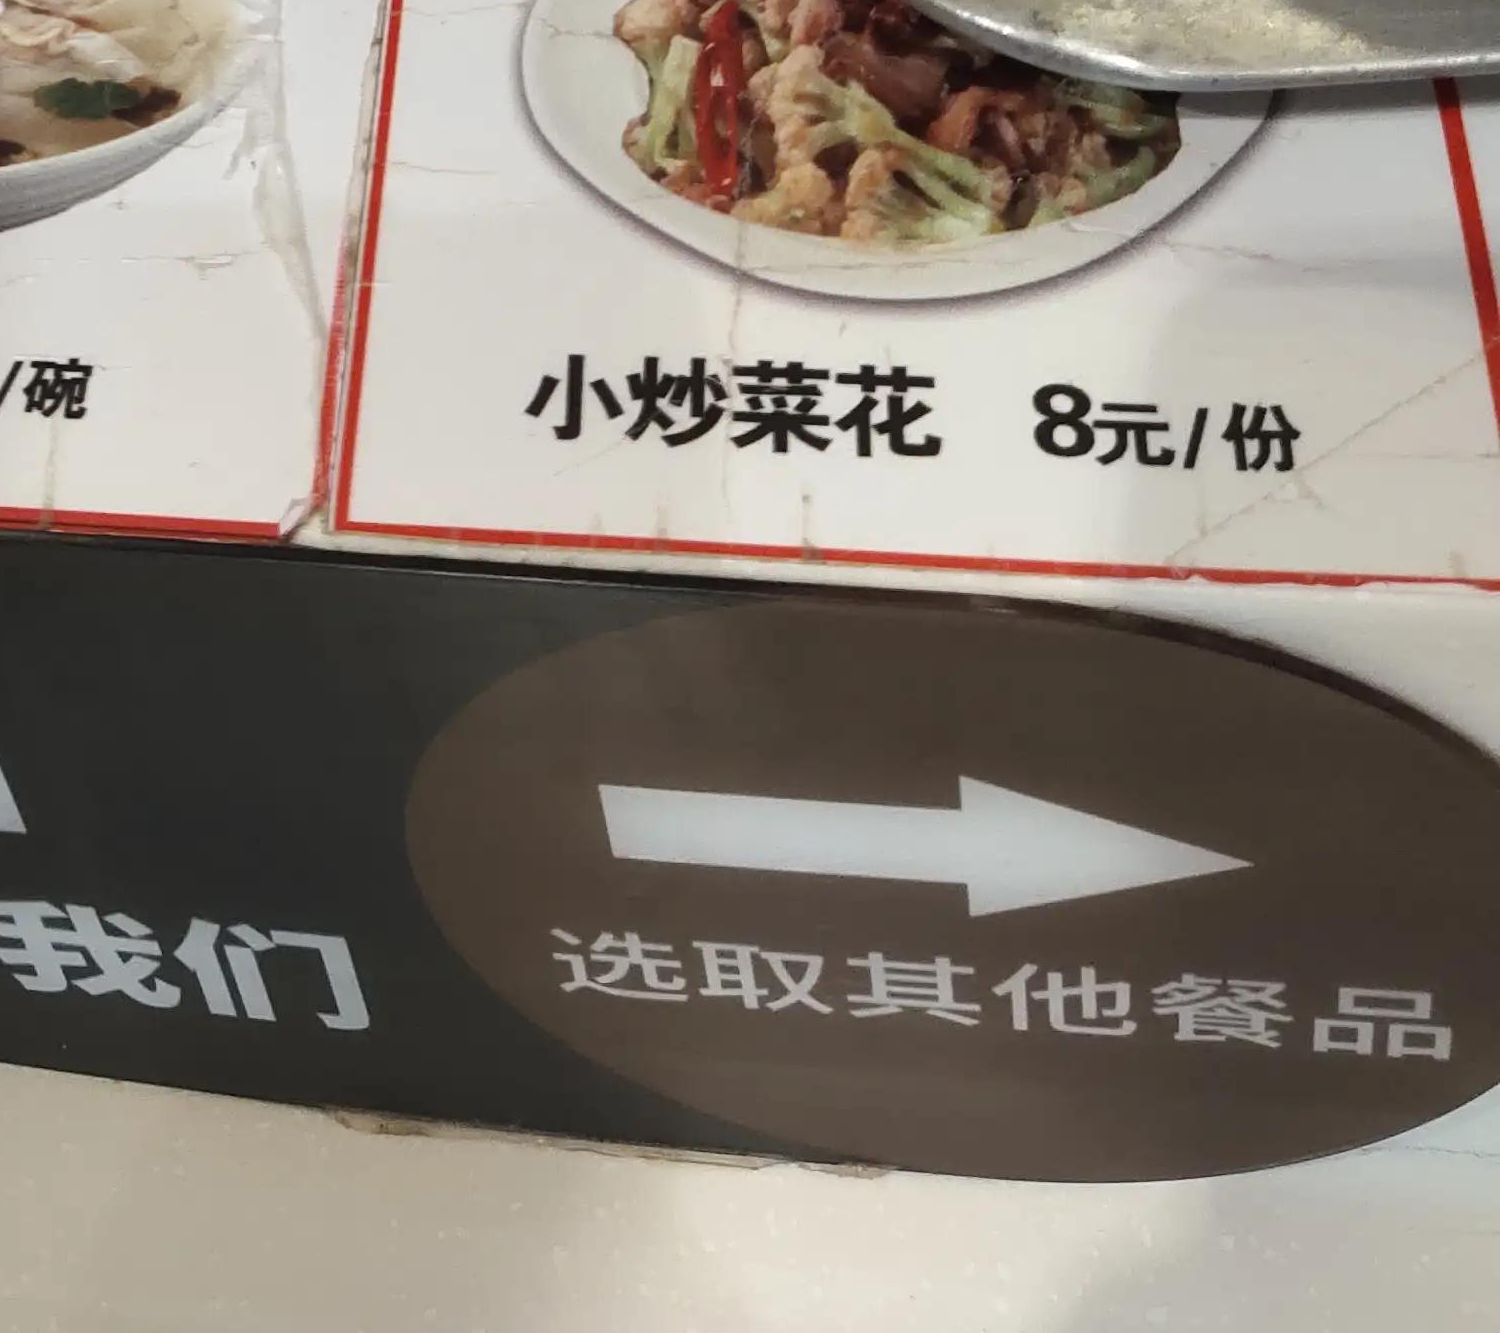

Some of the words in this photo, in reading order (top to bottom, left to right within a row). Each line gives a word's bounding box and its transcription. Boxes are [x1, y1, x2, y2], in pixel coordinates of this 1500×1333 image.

[524, 353, 942, 458] 小炒菜花
[1031, 383, 1301, 472] 8元/份
[549, 927, 1453, 1061] 选取其他餐品
